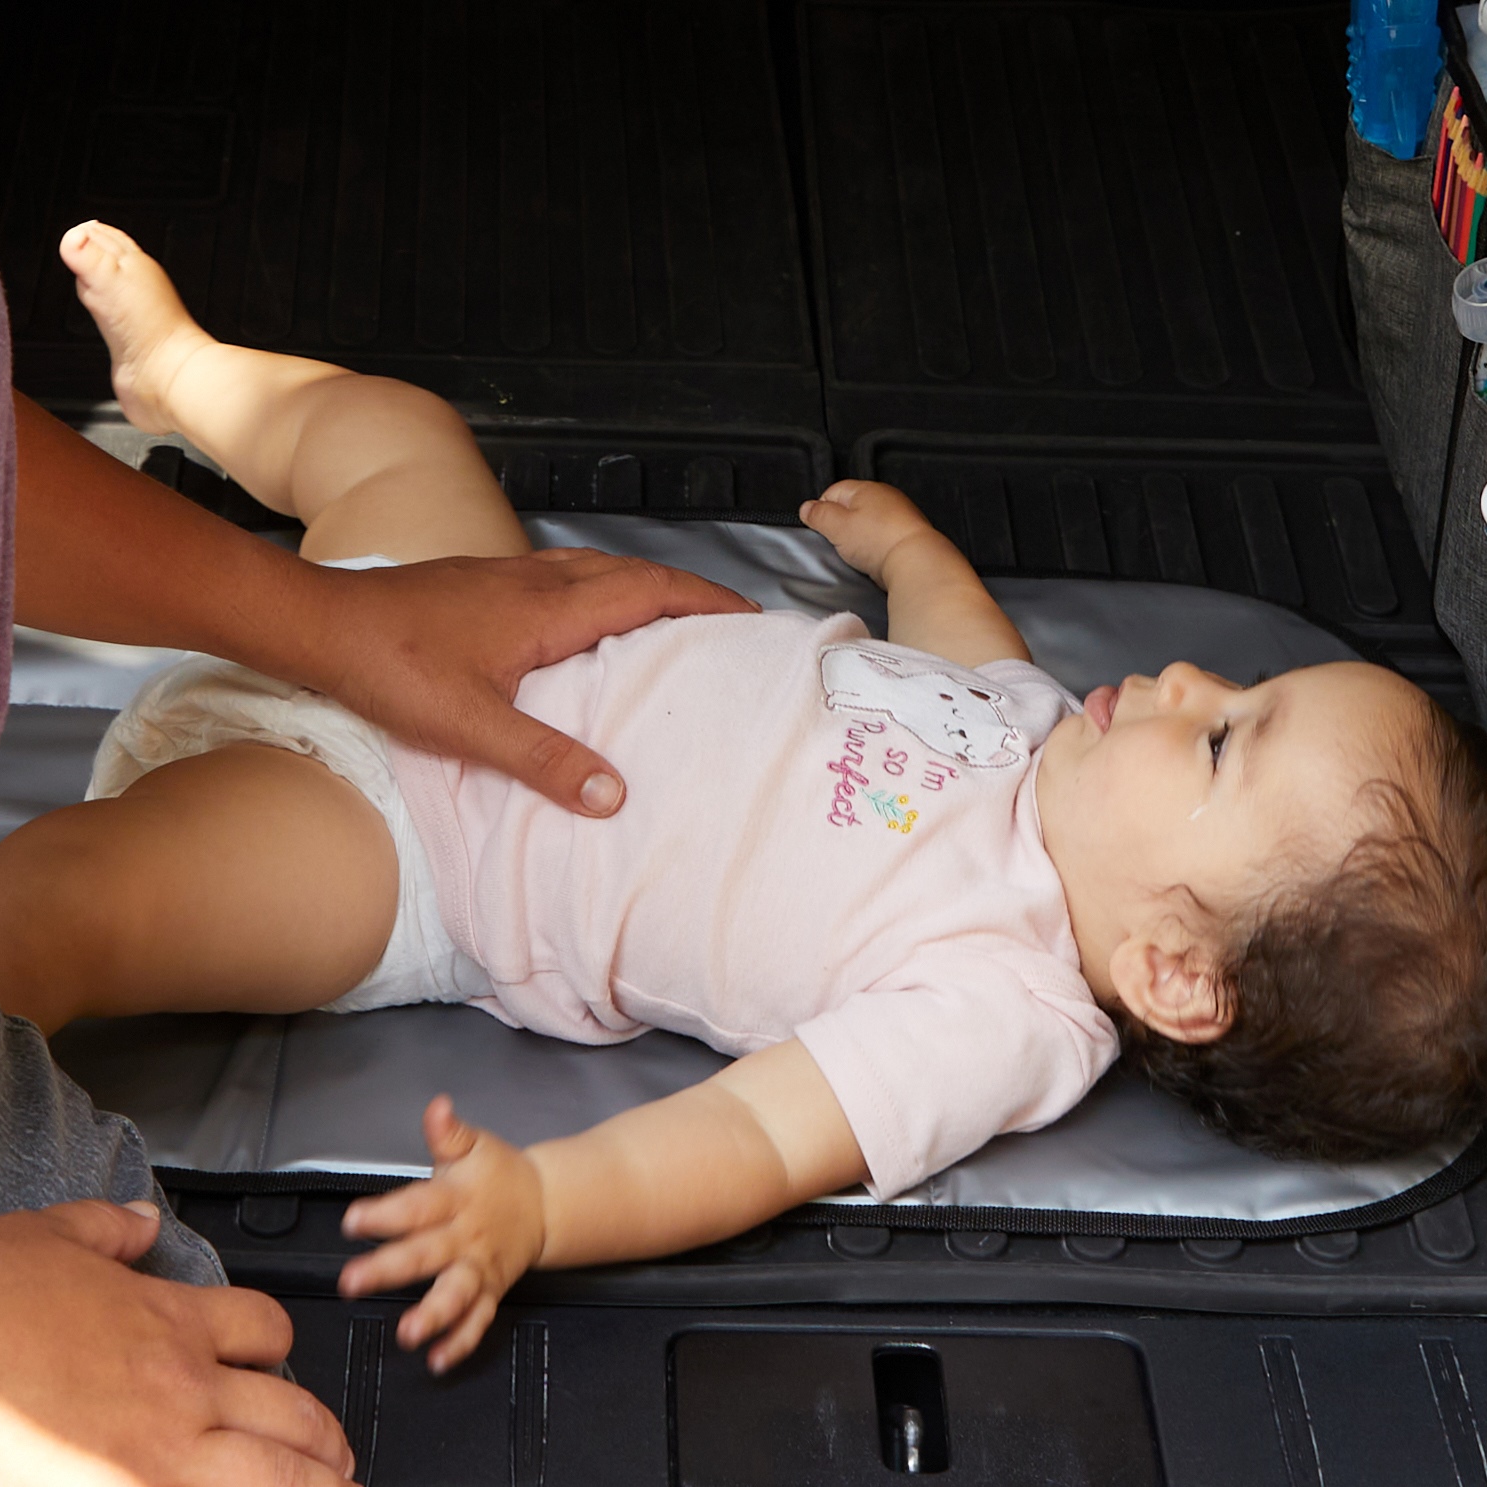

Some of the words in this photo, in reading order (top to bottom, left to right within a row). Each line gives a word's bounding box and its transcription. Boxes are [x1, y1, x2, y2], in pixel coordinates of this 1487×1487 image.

[826, 718, 887, 829] Purrfect
[883, 746, 908, 777] so
[921, 760, 960, 793] I'm
